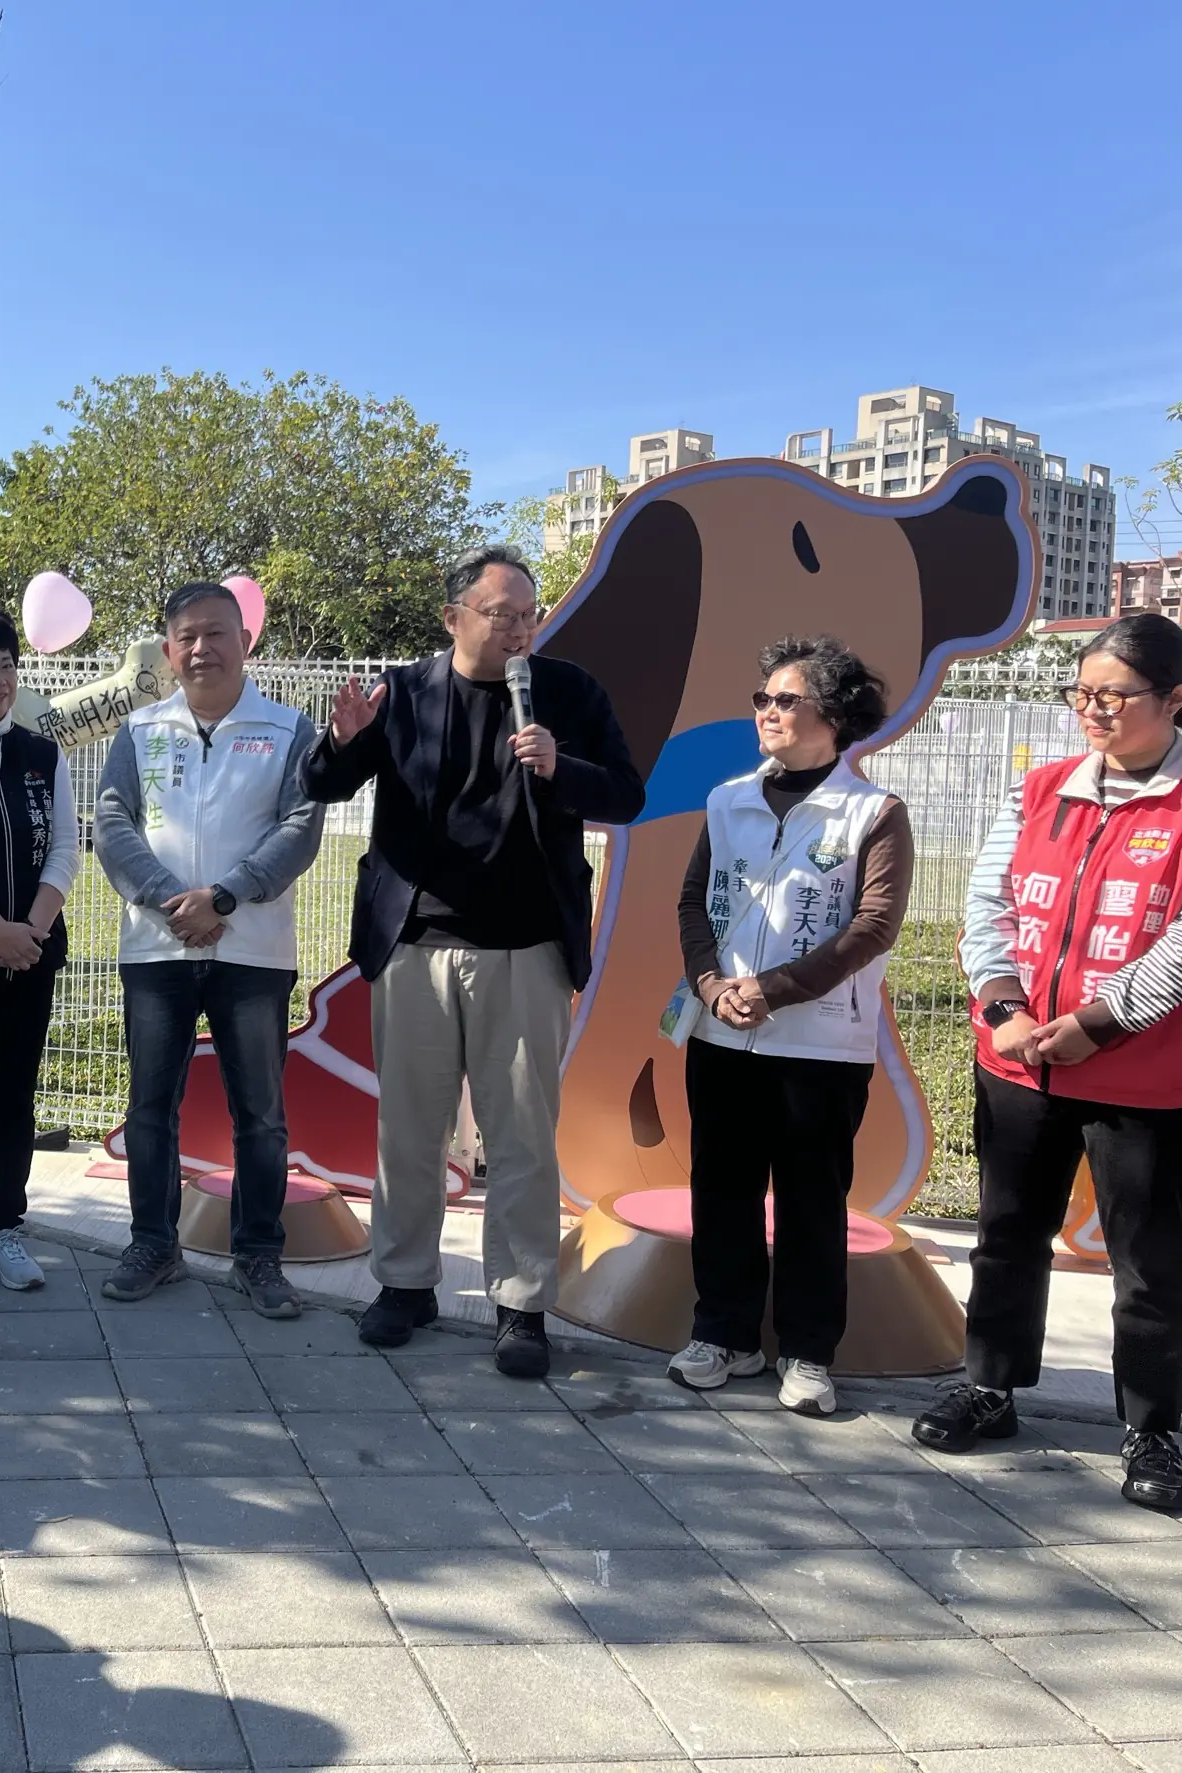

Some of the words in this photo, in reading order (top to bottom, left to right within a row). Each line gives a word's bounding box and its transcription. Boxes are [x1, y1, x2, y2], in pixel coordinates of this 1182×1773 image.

[35, 685, 134, 748] 聰明狗
[143, 736, 169, 831] 李天生
[172, 753, 186, 788] 市議員
[28, 808, 47, 868] 黃秀玲
[814, 854, 838, 865] 2024
[733, 858, 748, 893] 牽手
[709, 869, 730, 940] 陳麗娜
[824, 877, 846, 929] 市議員
[1142, 883, 1171, 935] 助理
